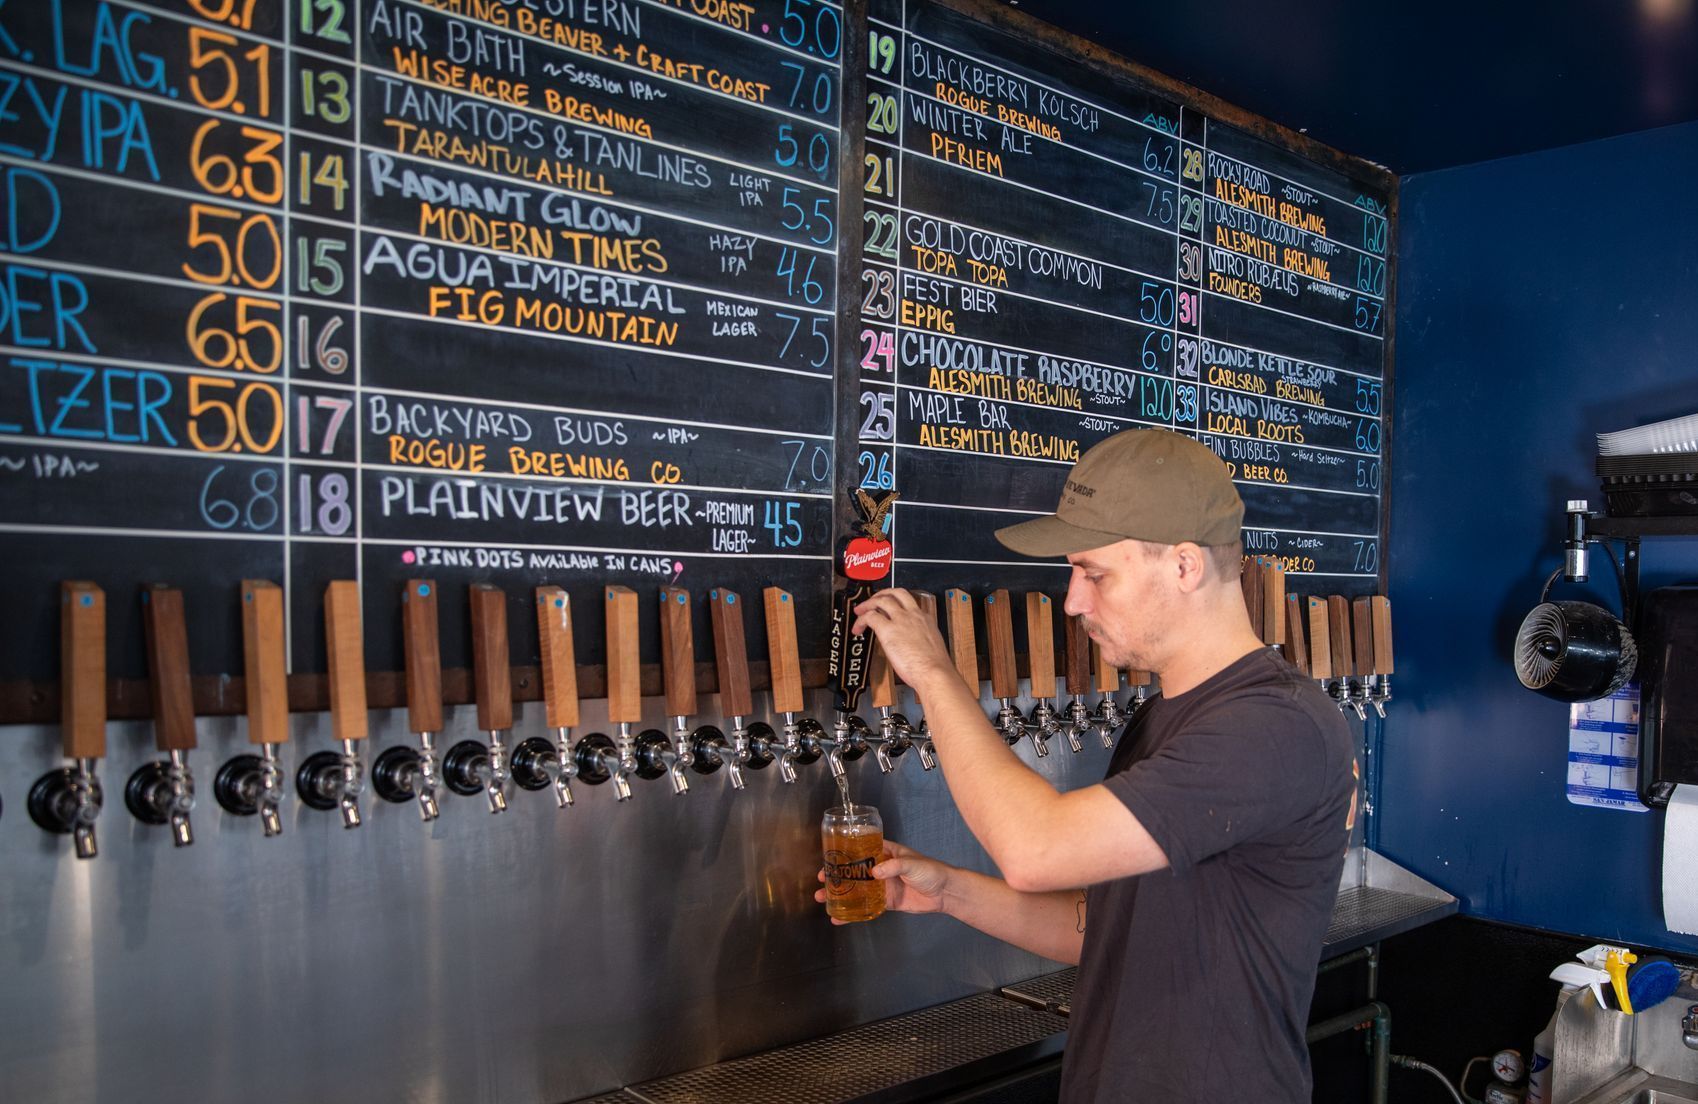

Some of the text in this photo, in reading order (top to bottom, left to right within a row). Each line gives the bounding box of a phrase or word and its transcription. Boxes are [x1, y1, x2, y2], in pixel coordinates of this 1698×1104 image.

[300, 0, 351, 44] 12
[369, 3, 526, 77] AIR BATH
[780, 0, 840, 58] 5.0
[53, 0, 178, 98] LAG.
[189, 27, 269, 117] 5.1
[516, 7, 771, 104] BEAVER + CRAFT COAST
[869, 30, 896, 75] 19
[300, 69, 351, 123] 13
[780, 60, 832, 114] 7.0
[912, 42, 1100, 133] BLACKBERRY KOLSCH
[375, 75, 712, 189] TANKTOPS & TANLINES
[544, 88, 654, 140] BREWING
[866, 92, 898, 135] 20
[910, 94, 1033, 155] WINTER ALE
[936, 82, 1061, 141] ROGUE BREWING
[1143, 112, 1179, 134] ABV
[81, 89, 160, 181] IPA
[775, 123, 830, 173] 5.0
[930, 132, 1003, 178] PFRIEM
[1143, 136, 1175, 175] 6.2
[190, 119, 283, 204] 6.3
[300, 152, 349, 211] 14
[729, 172, 772, 192] LIGHT
[864, 153, 894, 197] 21
[1182, 147, 1203, 182] 28
[1207, 152, 1271, 195] ROCKY ROAD
[367, 151, 642, 237] RADIANT GLOW
[739, 191, 763, 207] IPA
[782, 187, 834, 244] 5.5
[1143, 181, 1173, 224] 7.5
[1180, 194, 1201, 233] 29
[1215, 178, 1327, 239] ALESMITH BREWING
[1354, 194, 1387, 215] ABV
[182, 204, 281, 289] 5.0
[419, 202, 669, 274] MODERN TIMES
[863, 210, 898, 259] 22
[1205, 197, 1308, 250] TOASTED COCONUT
[297, 236, 346, 296] 15
[709, 234, 759, 261] HAZY
[721, 256, 747, 276] IPA
[905, 215, 1102, 290] GOLD COAST COMMON
[911, 244, 1009, 289] TOPA TOPA
[1178, 242, 1201, 282] 30
[1208, 246, 1244, 278] NITRO
[1216, 224, 1331, 283] ALESMITH BREWING
[363, 235, 687, 315] AGUA IMPERIAL
[777, 247, 823, 305] 4.6
[861, 269, 895, 319] 23
[903, 273, 998, 314] FEST BIER
[1209, 272, 1262, 303] FOUNDERS
[1357, 254, 1386, 296] 12.0
[428, 286, 679, 346] FIG MOUNTAIN
[706, 300, 760, 318] MEXICAN
[901, 298, 956, 334] EPPIG
[1140, 282, 1175, 327] 5.0
[1178, 291, 1197, 327] 31
[1355, 296, 1382, 332] 5.7
[186, 293, 284, 373] 6.5
[298, 316, 349, 374] 16
[712, 321, 758, 337] LAGER
[775, 312, 829, 368] 7.5
[860, 329, 894, 373] 24
[900, 331, 1136, 400] CHOCOLATE RASPBERRY
[1177, 338, 1198, 378] 32
[1201, 340, 1338, 386] BLONDE KETTLE SOUR
[929, 367, 1082, 411] ALESMITH BREWING
[1140, 375, 1173, 421] 12.0
[1175, 384, 1198, 422] 33
[1205, 387, 1299, 423] ISLAND VIBES
[1208, 366, 1325, 407] CARLSBAD BREWING
[1355, 378, 1381, 416] 5.5
[188, 376, 284, 453] 5.0
[298, 396, 353, 455] 17
[369, 394, 629, 446] BACKYARD BUDS
[859, 391, 894, 440] 25
[908, 390, 1012, 431] MAPLE BAR
[1208, 412, 1304, 444] LOCAL ROOTS
[389, 434, 487, 473] ROGUE
[508, 446, 630, 481] BREWING
[919, 423, 1080, 463] ALESMITH BREWING
[1230, 439, 1280, 462] BUBBLES
[1355, 418, 1380, 452] 6.0
[781, 440, 830, 489] 7.0
[859, 451, 893, 490] 26
[1243, 463, 1272, 481] BEER
[1355, 460, 1379, 489] 5.0
[200, 465, 279, 530] 6.8
[299, 473, 352, 536] 18
[380, 476, 693, 527] PLAINVIEW BEER
[763, 500, 805, 547] 4.5
[1246, 531, 1278, 550] NUTS
[414, 547, 672, 575] PINK DOTS IN CANS
[845, 547, 891, 569] Plainview
[1353, 541, 1377, 572] 7.0
[829, 609, 842, 677] LAGER
